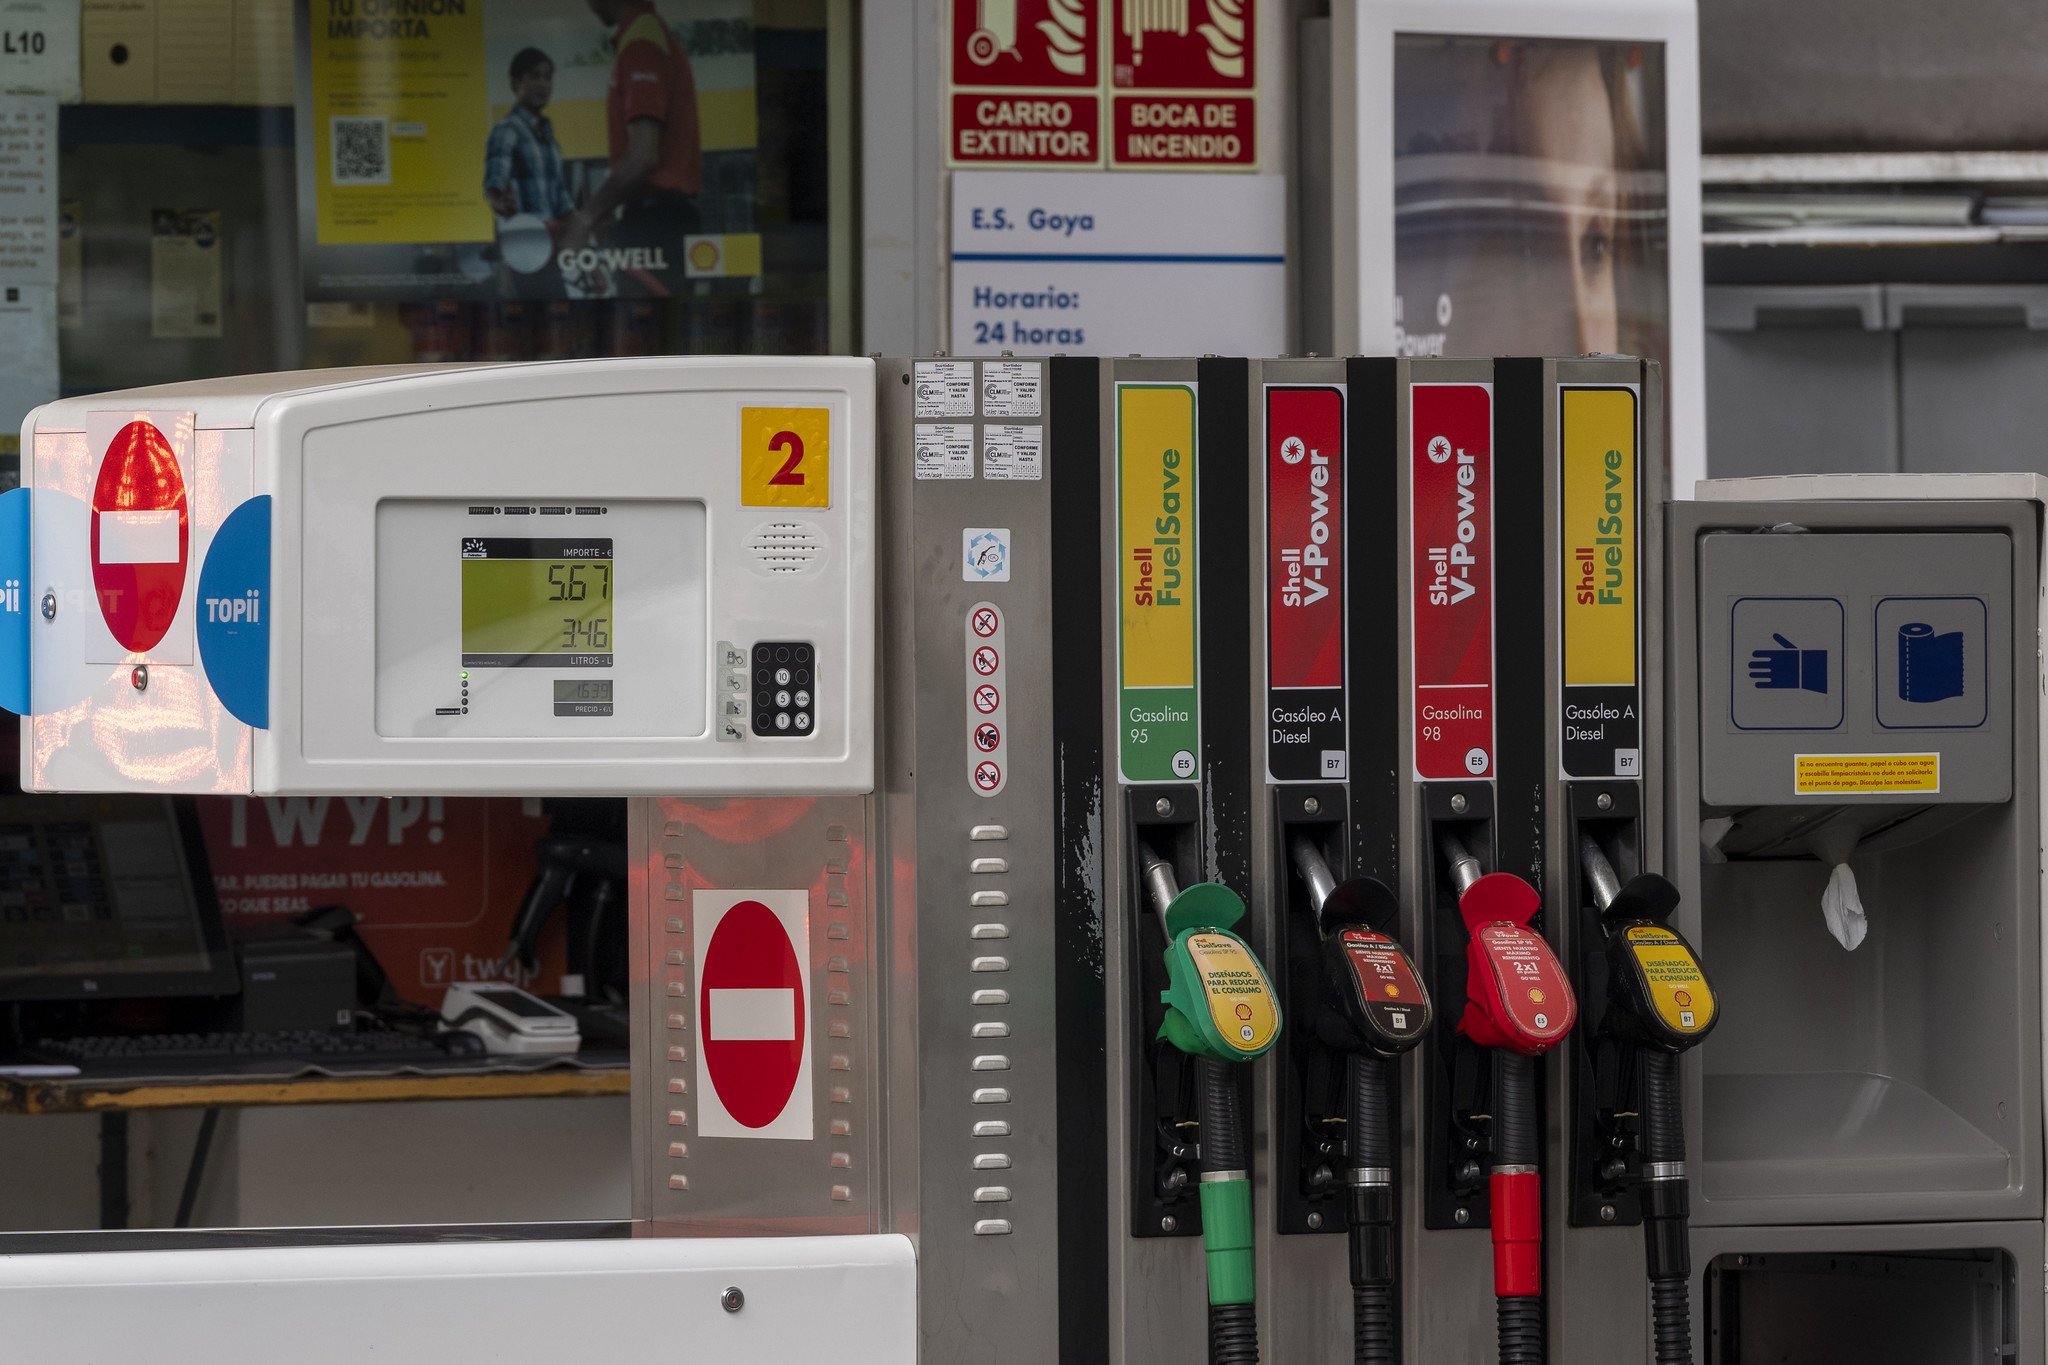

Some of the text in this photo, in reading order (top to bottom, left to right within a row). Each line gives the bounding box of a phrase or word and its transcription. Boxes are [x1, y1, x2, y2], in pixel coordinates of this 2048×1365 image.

[328, 18, 430, 39] IMPORTA
[4, 31, 45, 54] L10
[977, 101, 1072, 127] CARRO
[1131, 104, 1237, 128] BOCA DE
[960, 130, 1090, 157] EXTINTOR
[1128, 134, 1241, 159] INCENDIO
[972, 208, 1094, 236] E.S. Goya
[557, 247, 669, 272] GO WELL
[973, 286, 1080, 309] Horario:
[974, 320, 1085, 345] 24 horas
[768, 430, 805, 486] 2
[1154, 448, 1181, 606] FuelSave
[1303, 448, 1330, 607] V-Power
[1450, 448, 1476, 606] V-Power
[1596, 448, 1622, 605] FuelSave
[563, 548, 599, 557] IMPORTE
[548, 564, 609, 601] 5.67
[1134, 548, 1152, 607] Shell
[1282, 548, 1301, 608] Shell
[1429, 547, 1447, 606] Shell
[1576, 547, 1594, 606] Shell
[562, 618, 608, 649] 3.46
[570, 656, 612, 665] LITROS L
[778, 672, 787, 681] 10
[780, 694, 786, 703] 5
[575, 705, 598, 713] PRECIO
[1130, 705, 1188, 724] Gasolina
[1272, 705, 1342, 724] Gasóleo A
[1422, 703, 1483, 721] Gasolina
[1566, 701, 1635, 720] Gasóleo A
[781, 717, 785, 725] 1
[1130, 728, 1148, 744] 95
[1272, 728, 1311, 744] Diesel
[1422, 726, 1441, 742] 98
[1566, 725, 1604, 741] Diesel
[1178, 758, 1190, 769] E5
[1327, 759, 1340, 769] B7
[1471, 756, 1483, 766] E5
[1621, 757, 1633, 768] B7
[244, 873, 298, 890] PUEDES
[300, 872, 348, 889] PAGAR
[350, 872, 369, 888] TU
[239, 896, 271, 913] QUE
[1208, 970, 1253, 979] DISEÑADOS
[1373, 963, 1393, 972] 2x1
[1513, 961, 1538, 971] 2x1
[1221, 987, 1262, 995] CONSUMO
[1244, 1029, 1252, 1037] E5
